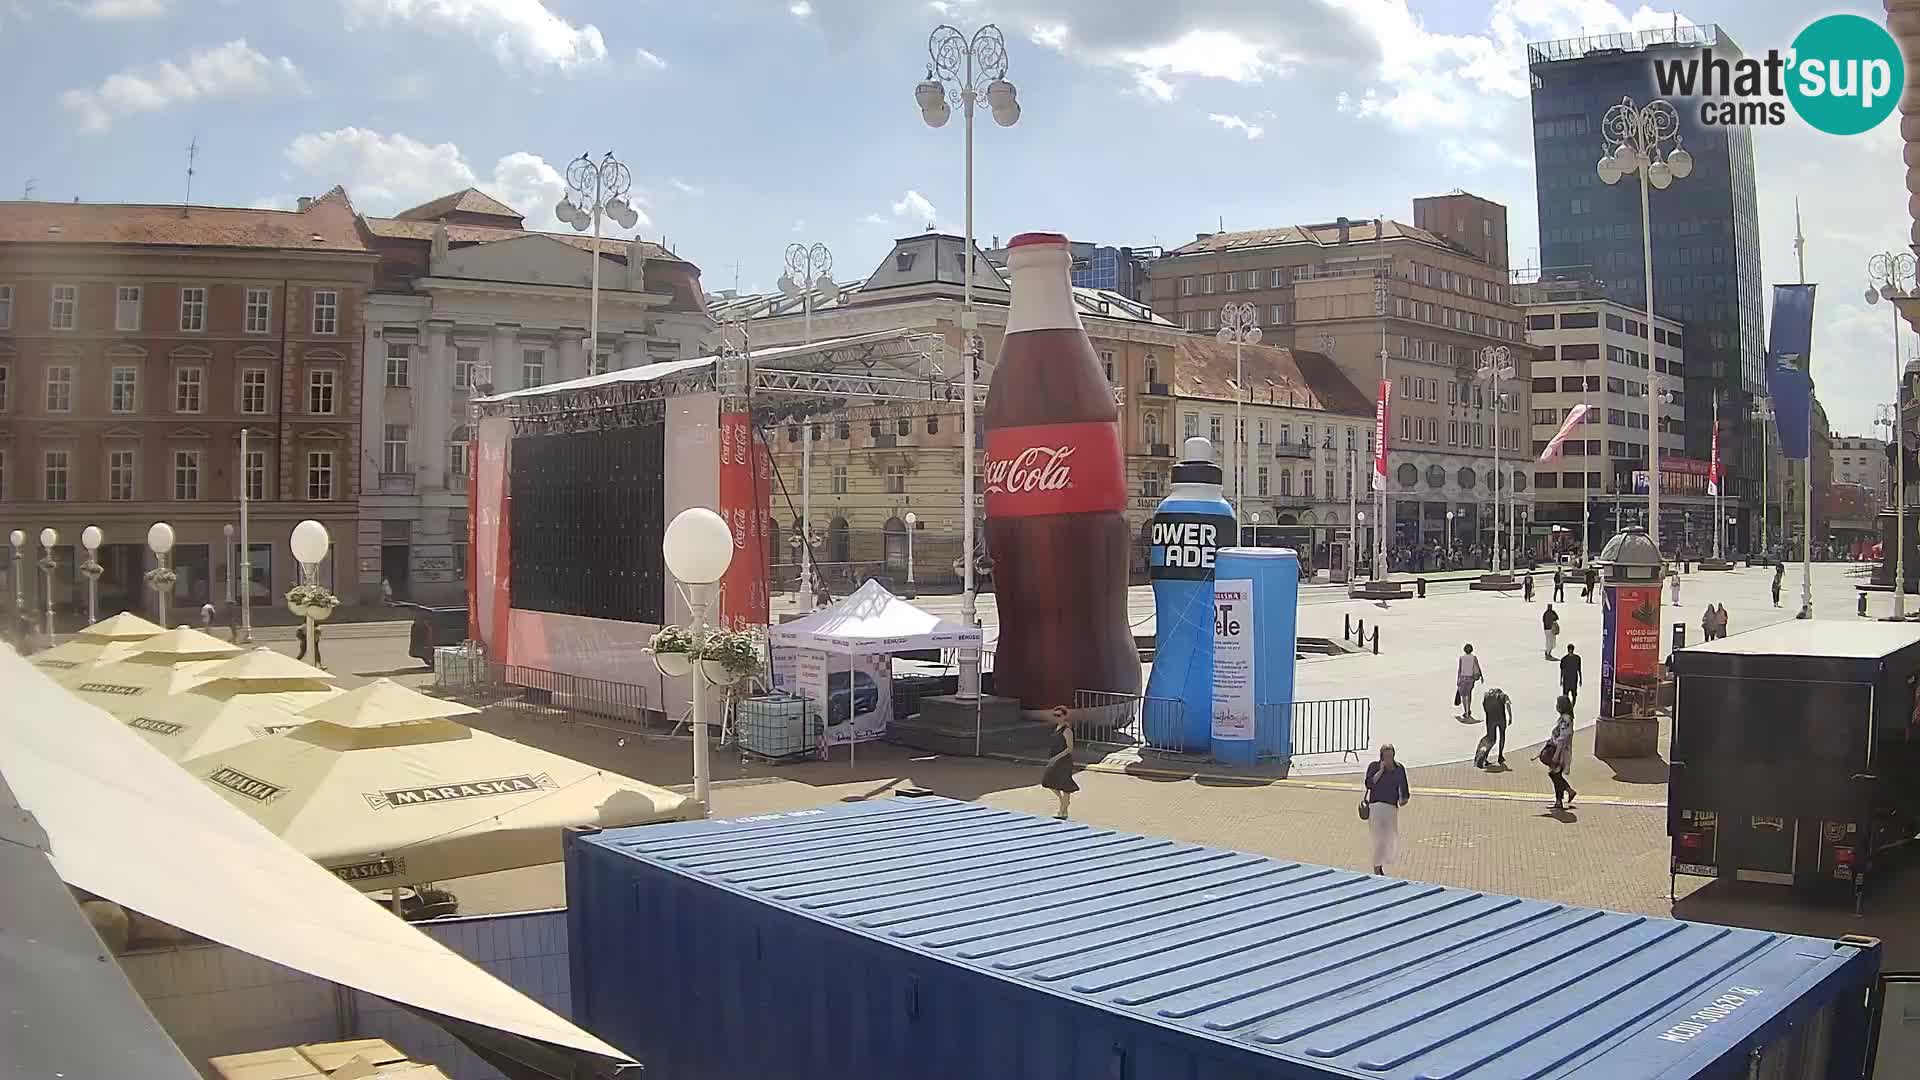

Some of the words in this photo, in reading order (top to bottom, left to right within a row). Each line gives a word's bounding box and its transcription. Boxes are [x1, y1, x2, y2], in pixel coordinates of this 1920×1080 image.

[735, 424, 746, 465] Coca-Cola
[1152, 523, 1217, 546] OWER
[1166, 545, 1216, 568] ADE
[1214, 604, 1240, 637] eTe
[214, 769, 277, 800] MARASKA
[396, 777, 533, 805] MARASKA
[336, 861, 391, 880] RASKA
[1656, 1020, 1709, 1044] MCDU
